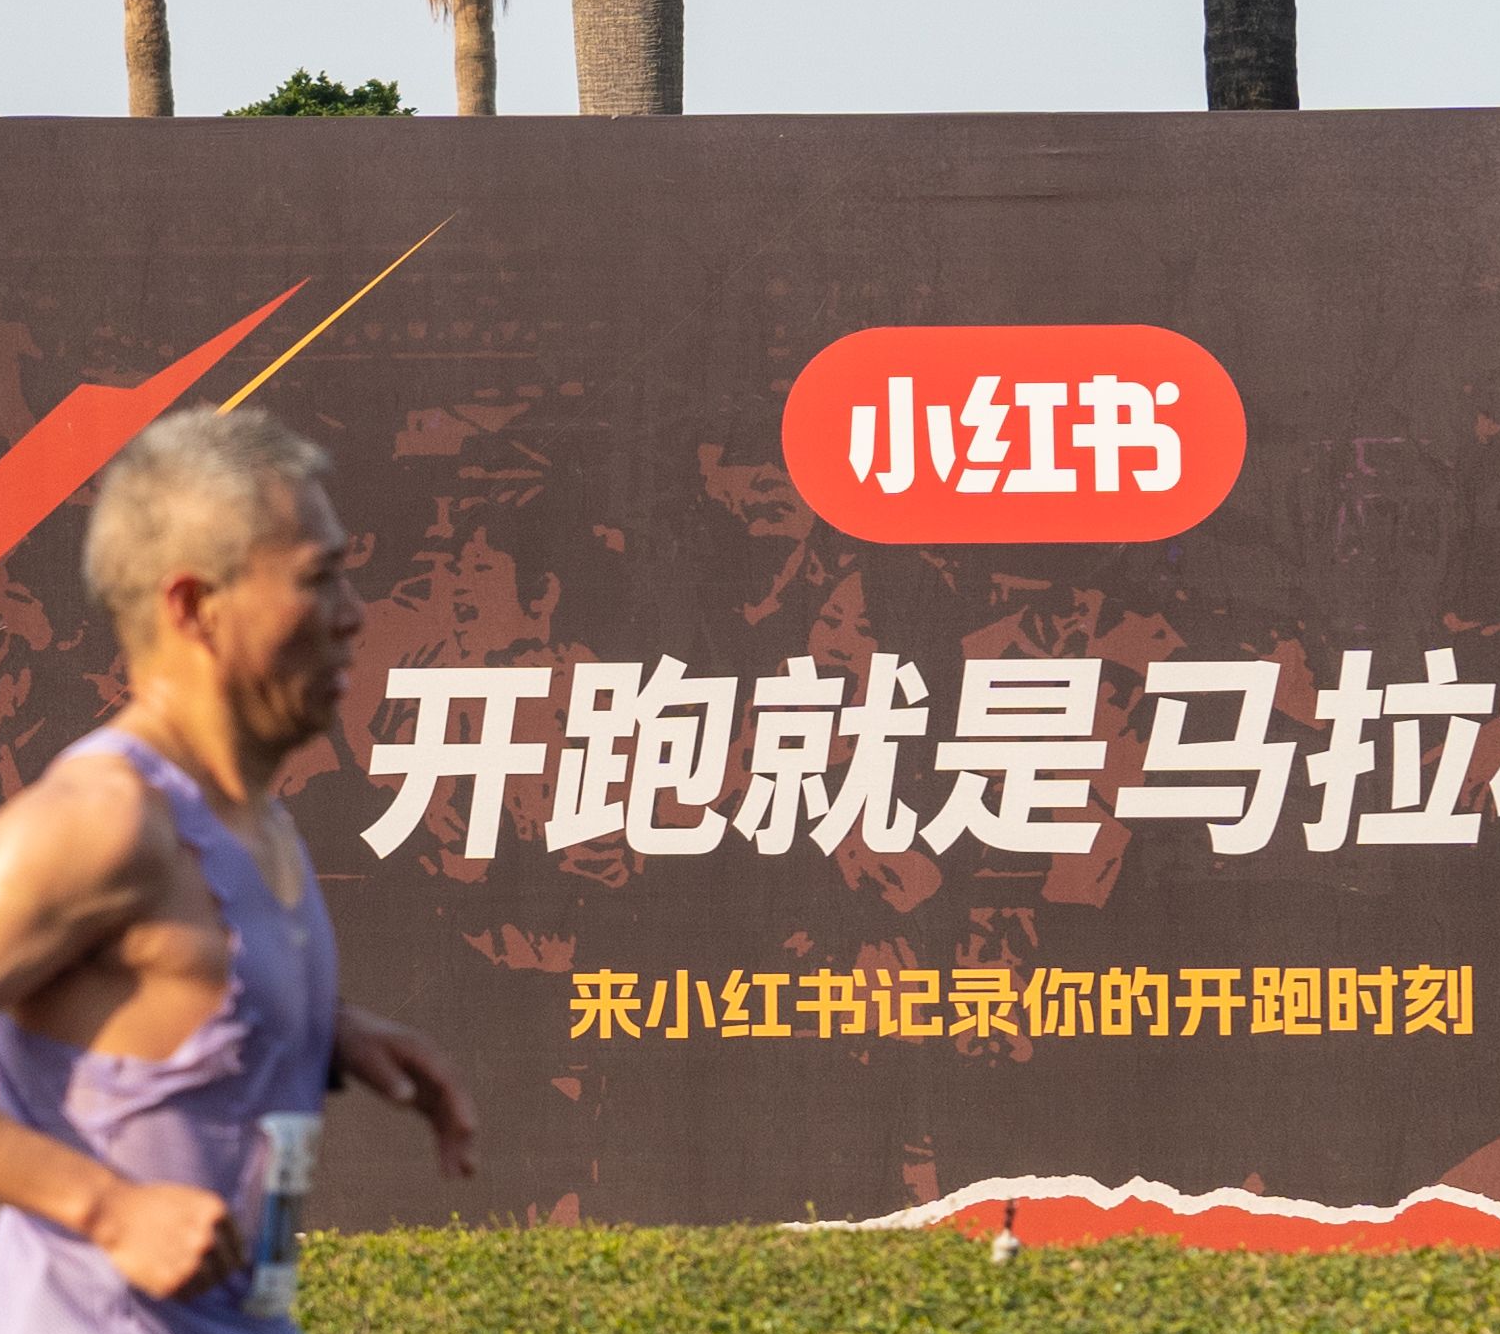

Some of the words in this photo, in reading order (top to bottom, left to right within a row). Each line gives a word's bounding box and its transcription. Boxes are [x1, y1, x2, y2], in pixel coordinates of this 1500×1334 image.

[848, 374, 1182, 494] 小红书
[569, 963, 1475, 1040] 来小红书记录你的开跑时刻
